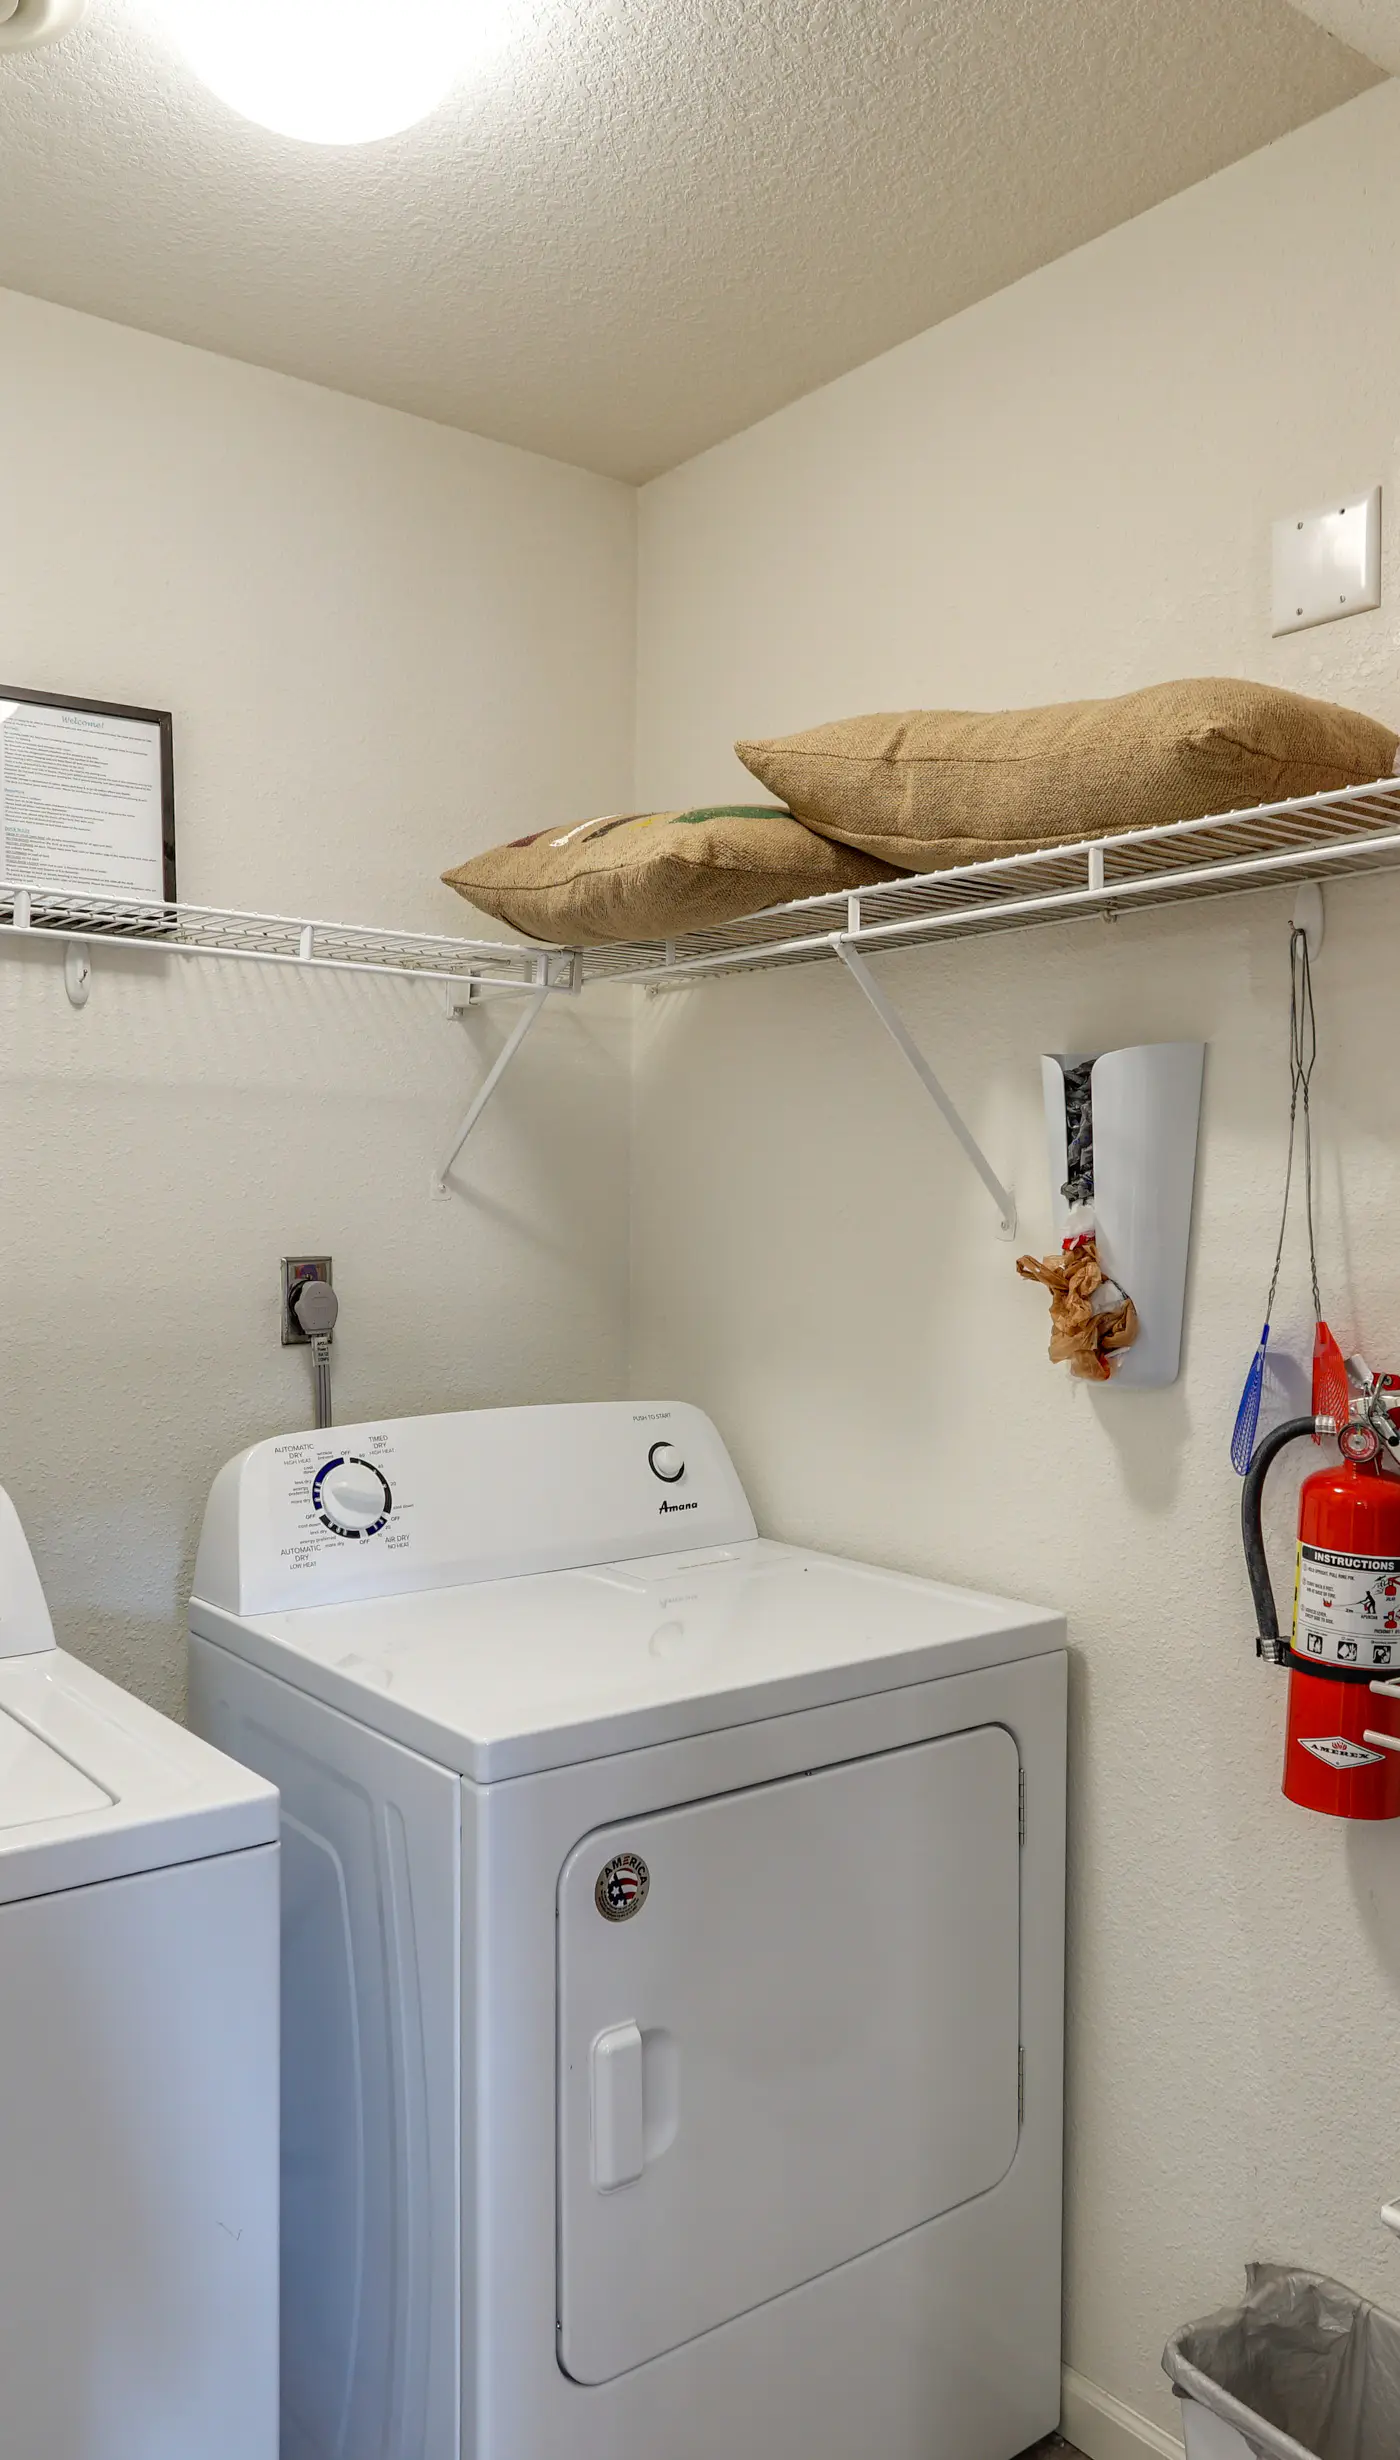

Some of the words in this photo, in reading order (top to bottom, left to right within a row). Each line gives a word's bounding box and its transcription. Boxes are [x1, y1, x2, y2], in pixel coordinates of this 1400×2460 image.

[61, 716, 104, 729] Welcome!
[275, 1444, 314, 1453] AUTOMATIC
[659, 1500, 698, 1515] Amana
[280, 1544, 322, 1556] AUTOMATIC
[295, 1554, 309, 1562] DRY
[1314, 1551, 1395, 1570] INSTRUCTIONS
[1311, 1744, 1370, 1759] AMEREX
[605, 1855, 647, 1886] AMERICA
